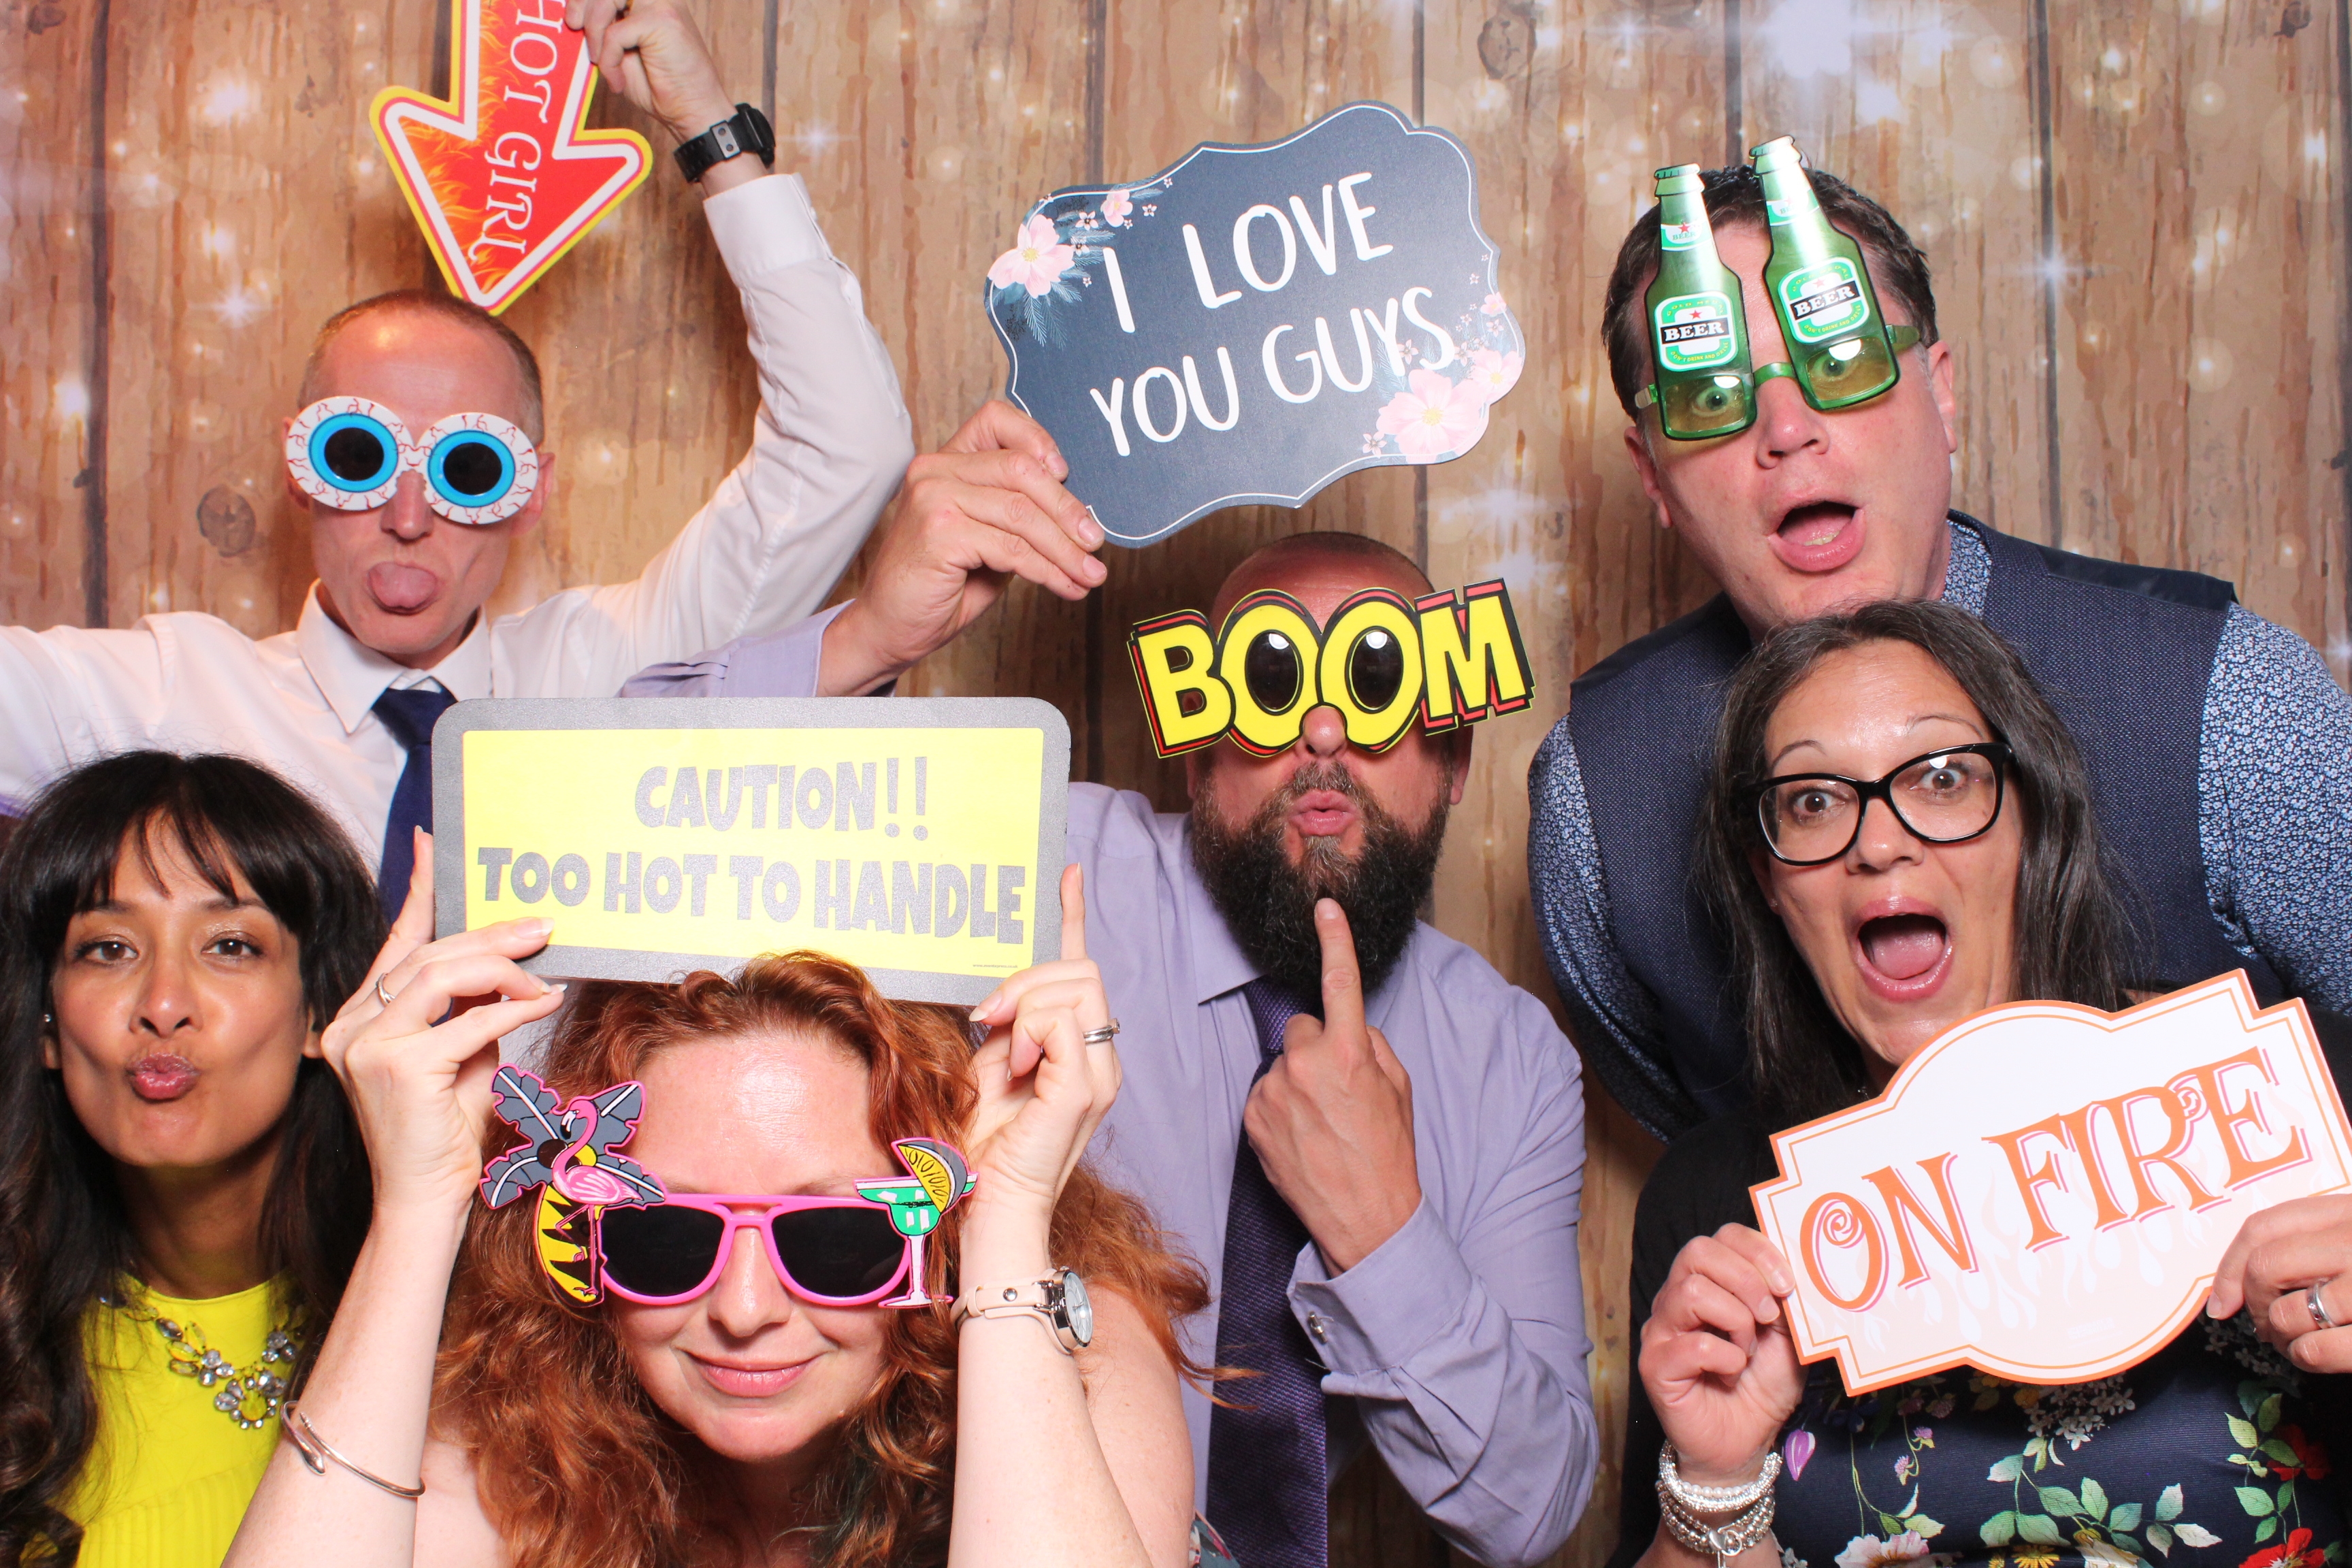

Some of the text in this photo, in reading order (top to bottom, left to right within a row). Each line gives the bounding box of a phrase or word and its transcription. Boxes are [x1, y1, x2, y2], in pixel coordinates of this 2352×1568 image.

[468, 0, 566, 261] HOT GIRL
[1102, 172, 1393, 333] I LOVE
[1672, 232, 1696, 241] BEER
[1664, 322, 1725, 342] BEER
[1667, 302, 1693, 316] GOLD
[1793, 286, 1855, 317] BEER
[1803, 325, 1821, 333] DON'T
[1822, 323, 1838, 332] DRINK
[1850, 305, 1861, 321] DRIVE
[1090, 287, 1455, 457] YOU GUYS
[1671, 351, 1686, 362] DON'T
[1716, 342, 1729, 357] DRIVE
[1132, 583, 1531, 755] BOOM
[634, 756, 929, 841] CAUTION!!
[476, 847, 1026, 945] TOO HOT TO HANDLE
[1799, 1046, 2313, 1313] ON FIRE
